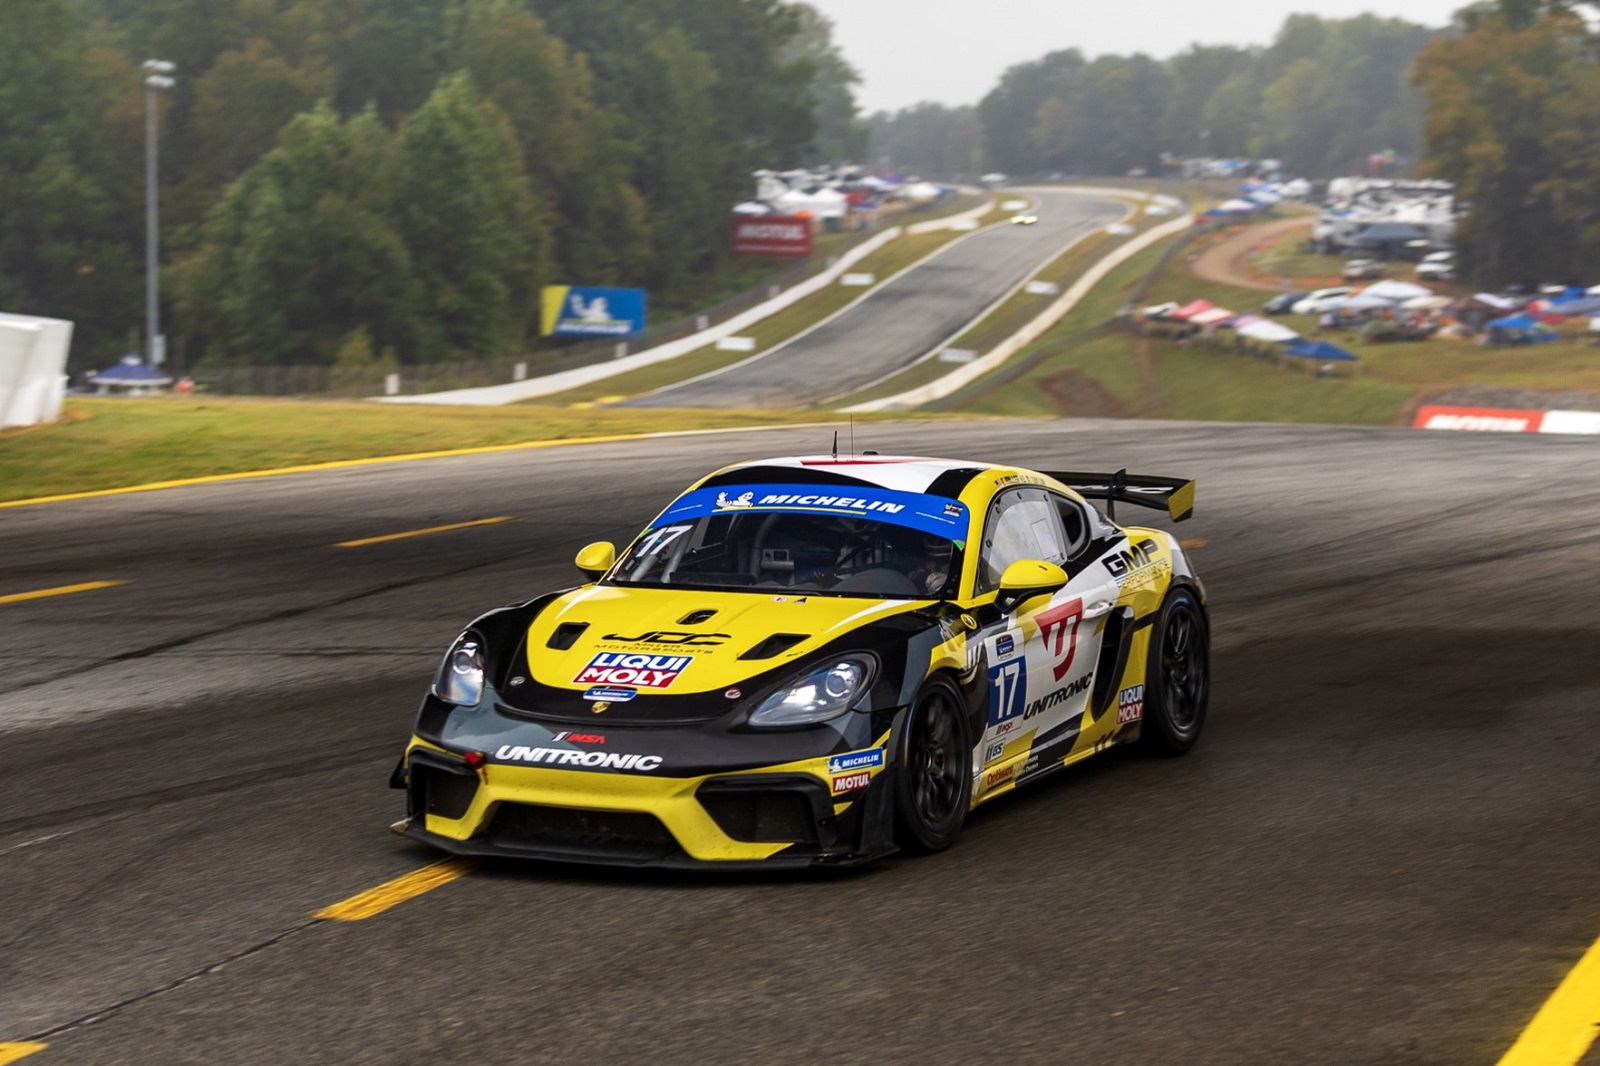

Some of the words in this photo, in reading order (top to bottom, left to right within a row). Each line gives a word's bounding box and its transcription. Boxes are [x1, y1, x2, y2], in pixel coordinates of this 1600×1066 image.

[758, 494, 905, 514] MICHELIN
[635, 524, 693, 557] 17
[1101, 538, 1158, 577] GMP
[593, 644, 714, 654] MOTORSPORTS
[592, 653, 688, 671] LIQUI
[578, 667, 679, 686] MOLY
[994, 661, 1020, 719] 17
[1023, 671, 1094, 720] UNITRONIC
[1120, 685, 1143, 706] LIQUI
[1117, 702, 1143, 723] MOLY
[495, 744, 663, 771] UNITRONIC
[842, 754, 879, 767] MICHELIN
[835, 773, 869, 791] MOTUL
